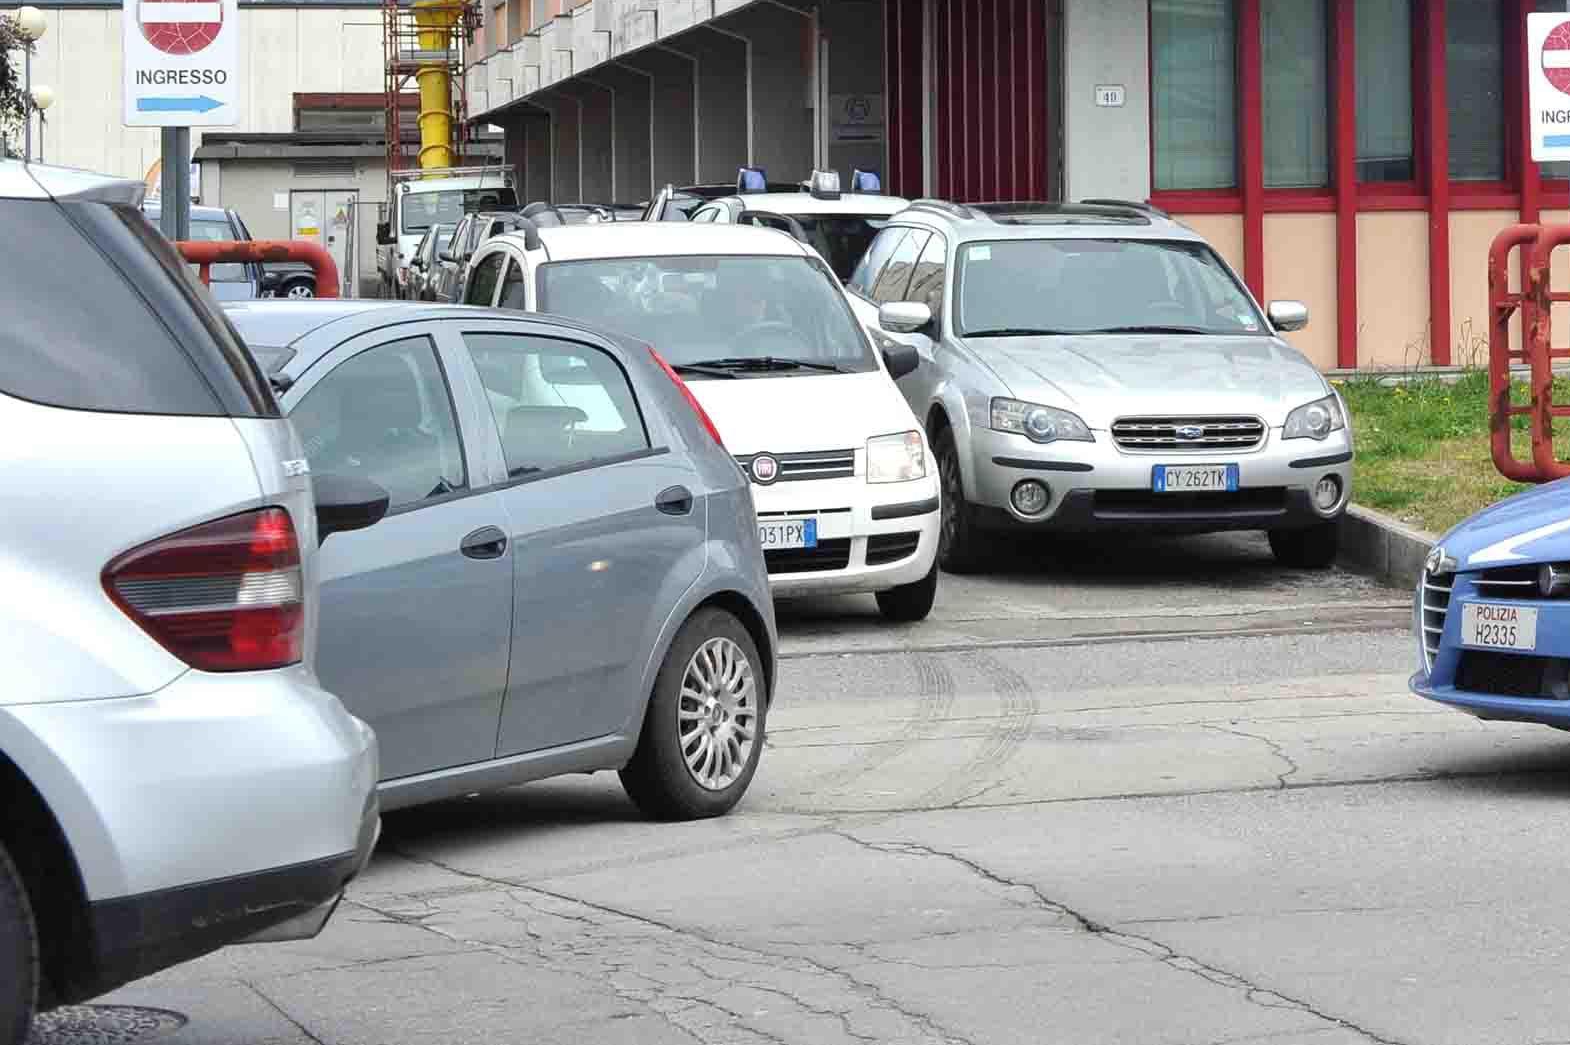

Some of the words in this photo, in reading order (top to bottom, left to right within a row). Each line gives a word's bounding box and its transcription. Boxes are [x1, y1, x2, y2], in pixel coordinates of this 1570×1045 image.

[135, 69, 228, 85] INGRESSO
[1476, 606, 1519, 622] POLIZIA
[1475, 623, 1517, 646] H2335
